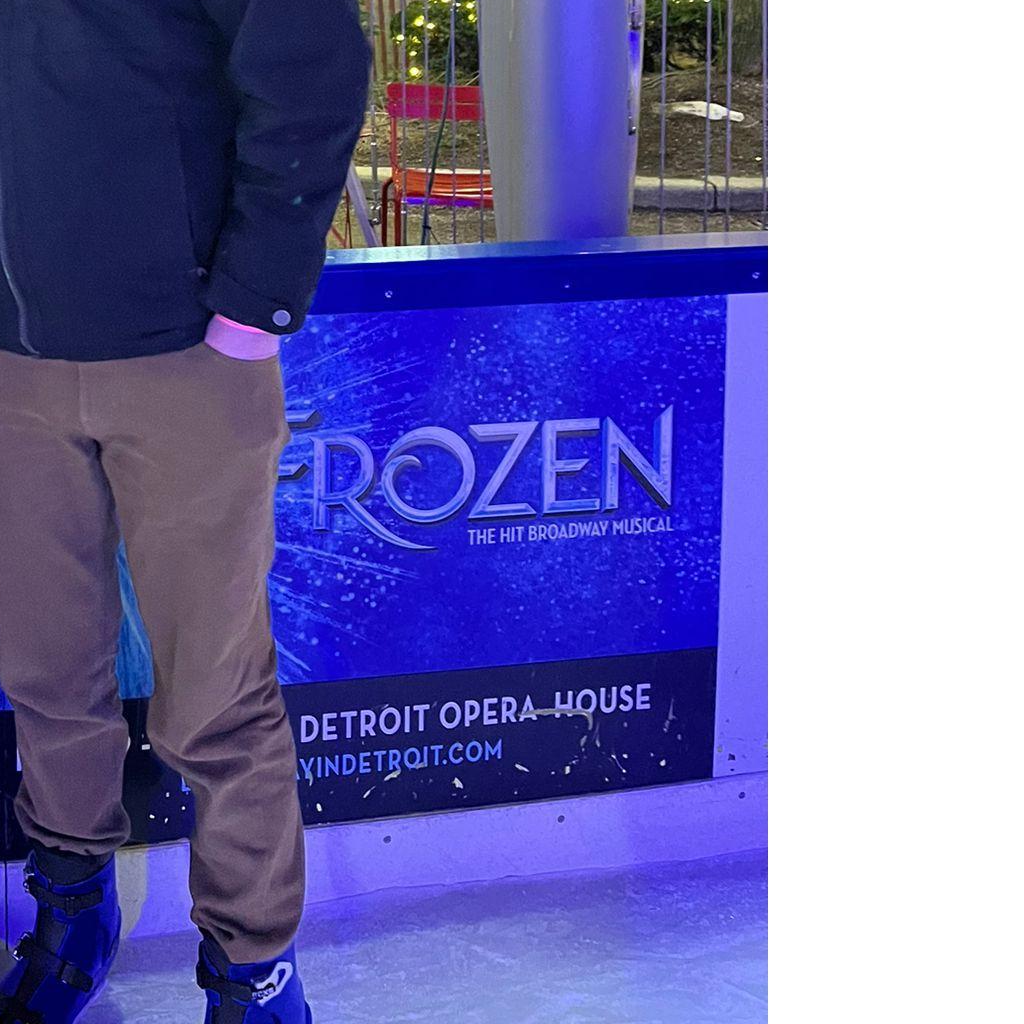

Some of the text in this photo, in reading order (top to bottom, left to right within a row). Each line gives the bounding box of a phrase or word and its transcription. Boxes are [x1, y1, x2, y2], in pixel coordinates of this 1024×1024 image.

[467, 516, 674, 545] THE HIT BROADWAY MUSICAL
[300, 683, 652, 743] DETROIT OPERA HOUSE
[295, 738, 503, 781] YINDETROIT.COM
